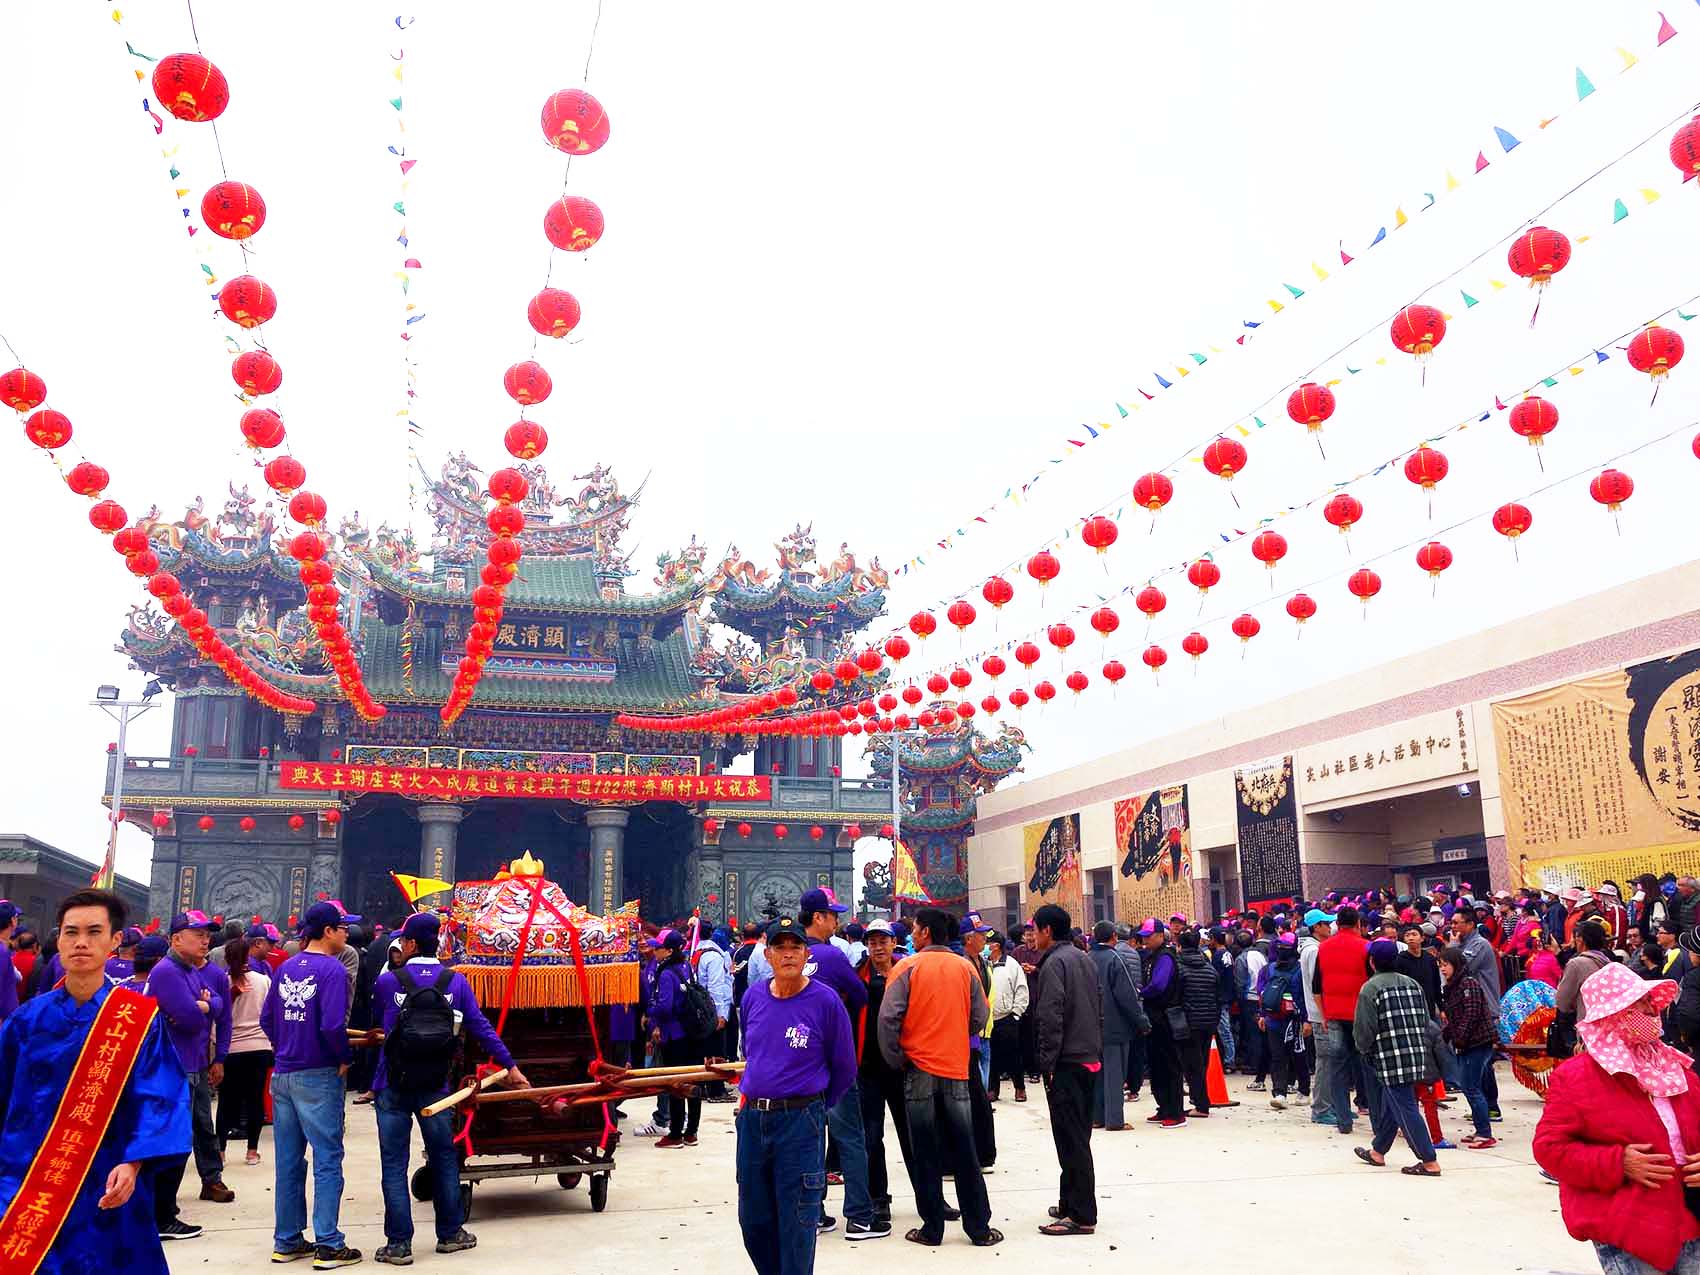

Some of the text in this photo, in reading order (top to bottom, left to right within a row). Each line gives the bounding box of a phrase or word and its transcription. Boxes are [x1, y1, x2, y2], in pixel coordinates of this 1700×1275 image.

[1305, 735, 1451, 782] 尖山社區老人活動中心
[1652, 746, 1671, 785] 謝安
[68, 1001, 137, 1126] 尖山村顯濟殿
[2, 1191, 54, 1261] 王經邦
